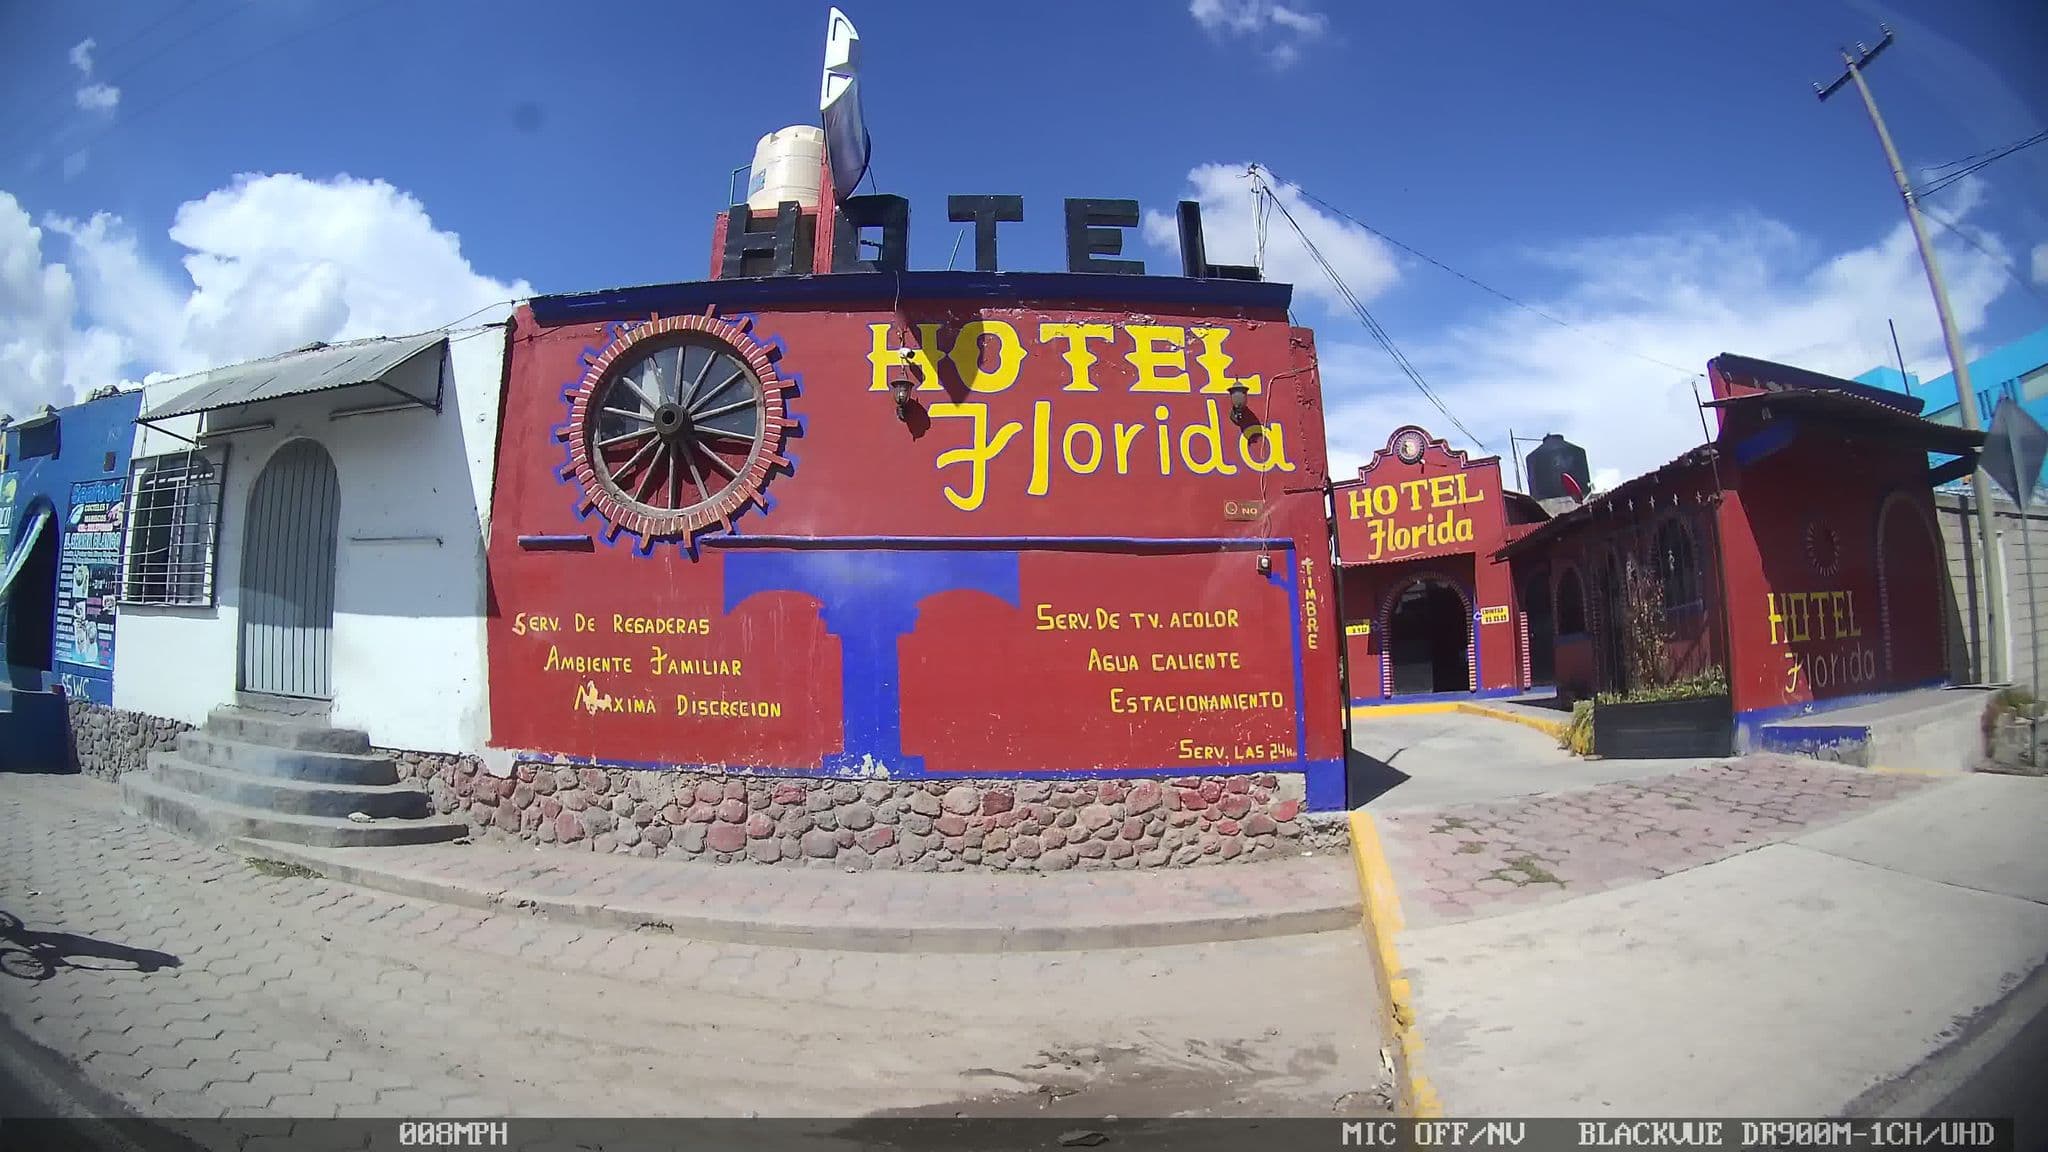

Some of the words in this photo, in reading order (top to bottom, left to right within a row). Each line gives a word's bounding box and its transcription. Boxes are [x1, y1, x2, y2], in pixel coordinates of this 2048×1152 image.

[722, 194, 1262, 282] HOTEL
[867, 320, 1263, 394] HOTEL
[928, 399, 1295, 510] Florida
[1242, 507, 1258, 515] NO
[1348, 473, 1484, 519] HOTEL
[1367, 510, 1474, 560] Florida
[1301, 557, 1318, 649] TIMBRE
[1767, 591, 1861, 644] HOTEL
[1087, 648, 1139, 672] AGUA
[1151, 652, 1241, 672] CALIENTE
[1785, 642, 1875, 693] Florida
[1110, 688, 1283, 714] ESTACIONAMIENTO
[1234, 744, 1265, 760] LAS
